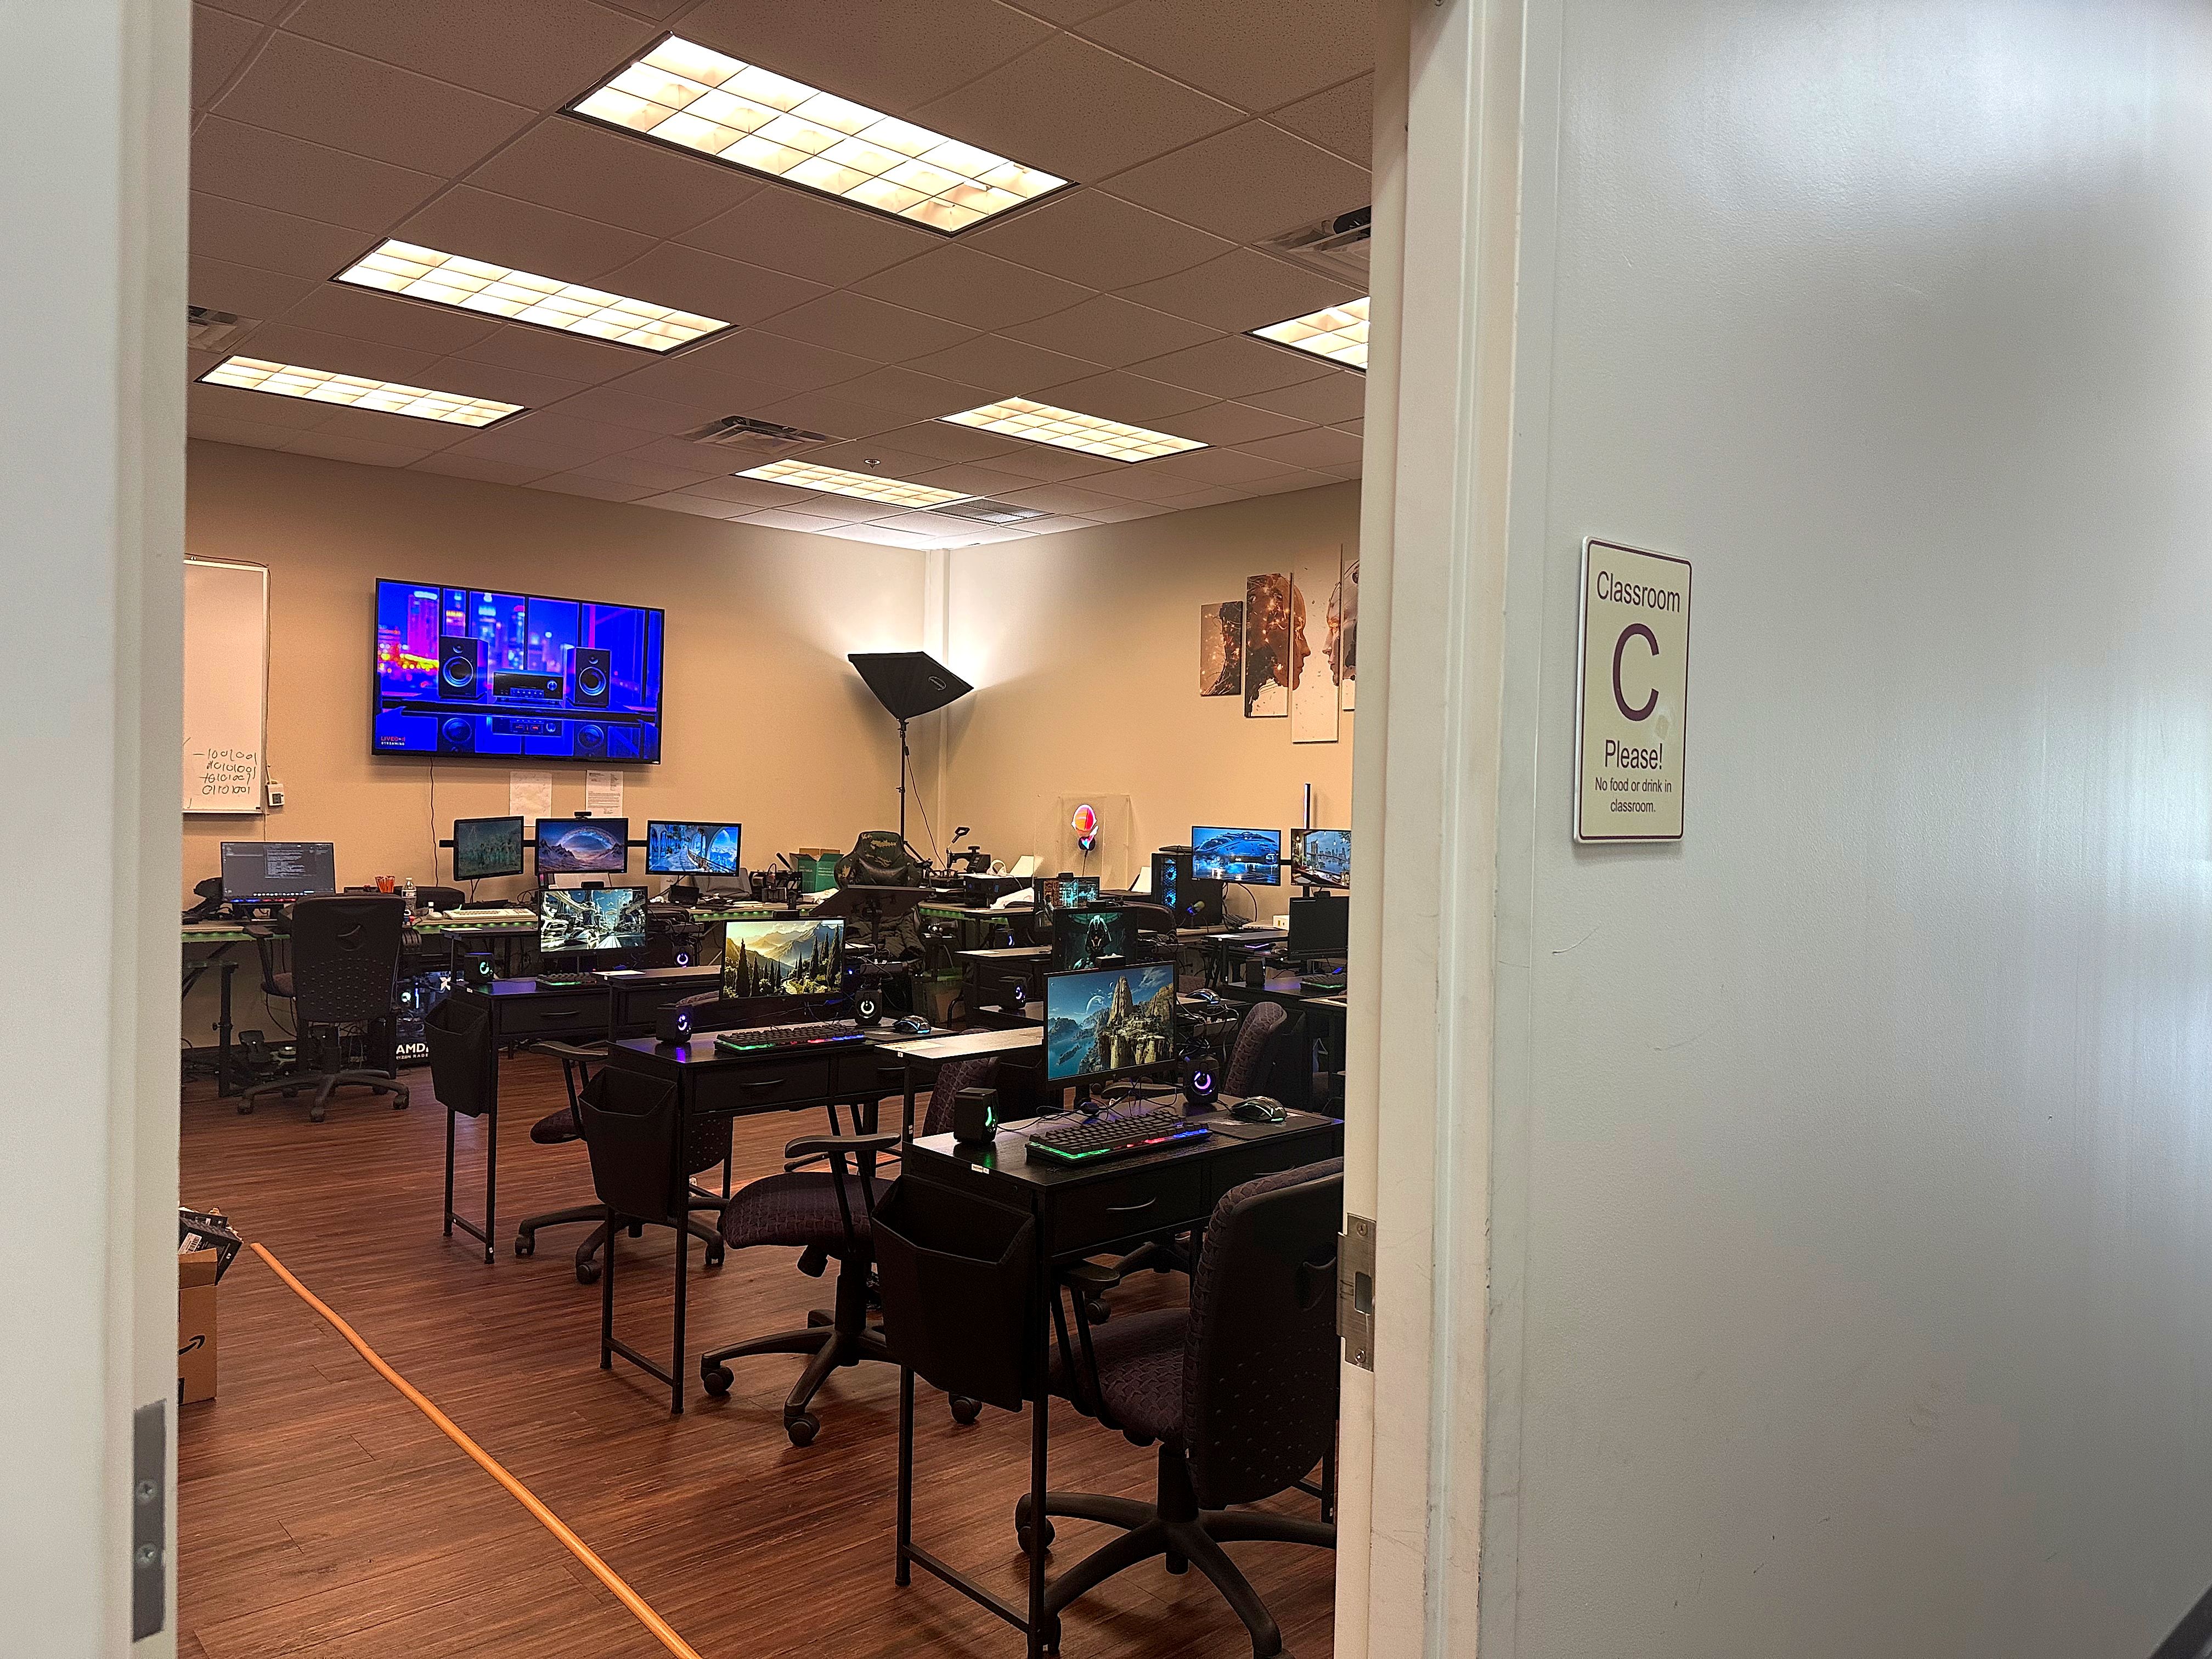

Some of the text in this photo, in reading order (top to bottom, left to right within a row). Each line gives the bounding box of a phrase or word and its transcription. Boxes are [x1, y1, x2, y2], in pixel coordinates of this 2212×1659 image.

[1596, 571, 1680, 613] Classroom
[1612, 623, 1660, 722] C
[1605, 739, 1663, 770] Please!
[1595, 777, 1672, 793] No food or drink in
[1610, 798, 1656, 812] classroom.
[396, 1043, 426, 1054] AMD
